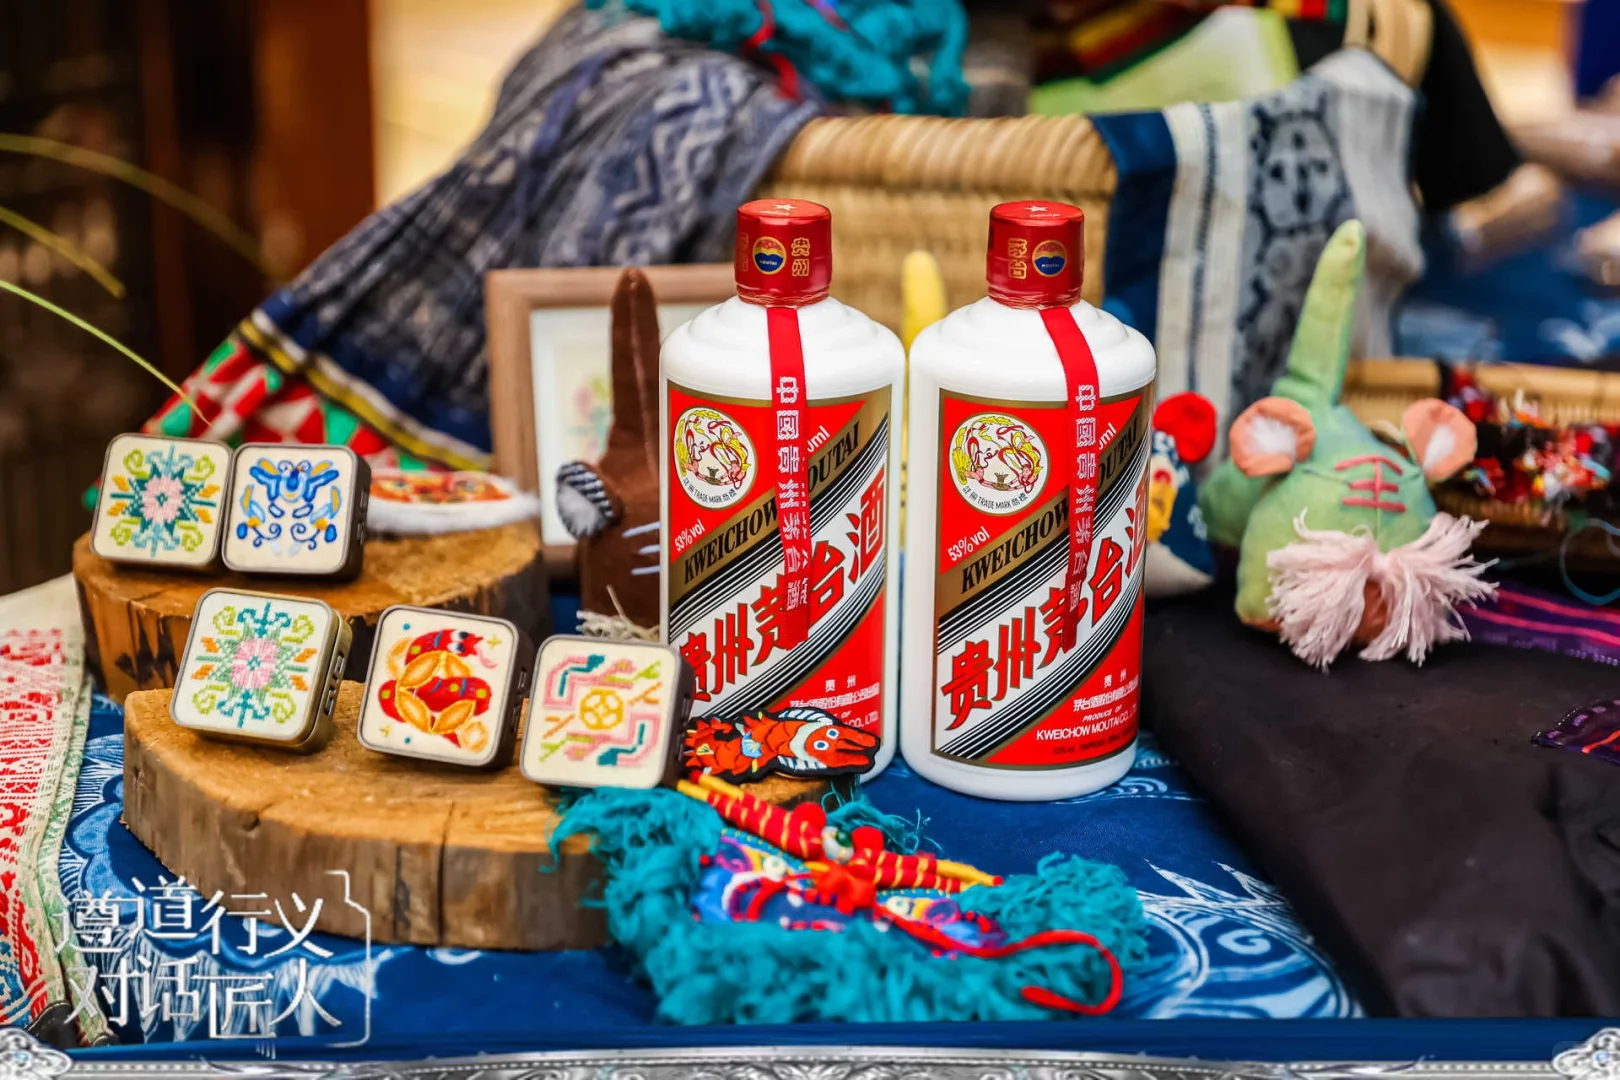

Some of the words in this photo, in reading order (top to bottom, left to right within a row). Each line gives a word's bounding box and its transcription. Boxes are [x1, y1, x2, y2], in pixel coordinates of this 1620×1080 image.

[683, 497, 777, 585] KWEICHOW
[808, 420, 860, 494] OUTAI
[961, 496, 1069, 595] KWEICHOW
[1097, 416, 1138, 492] OUTAI
[1036, 723, 1091, 741] KWEICHOW
[1091, 713, 1120, 734] MOUTAI
